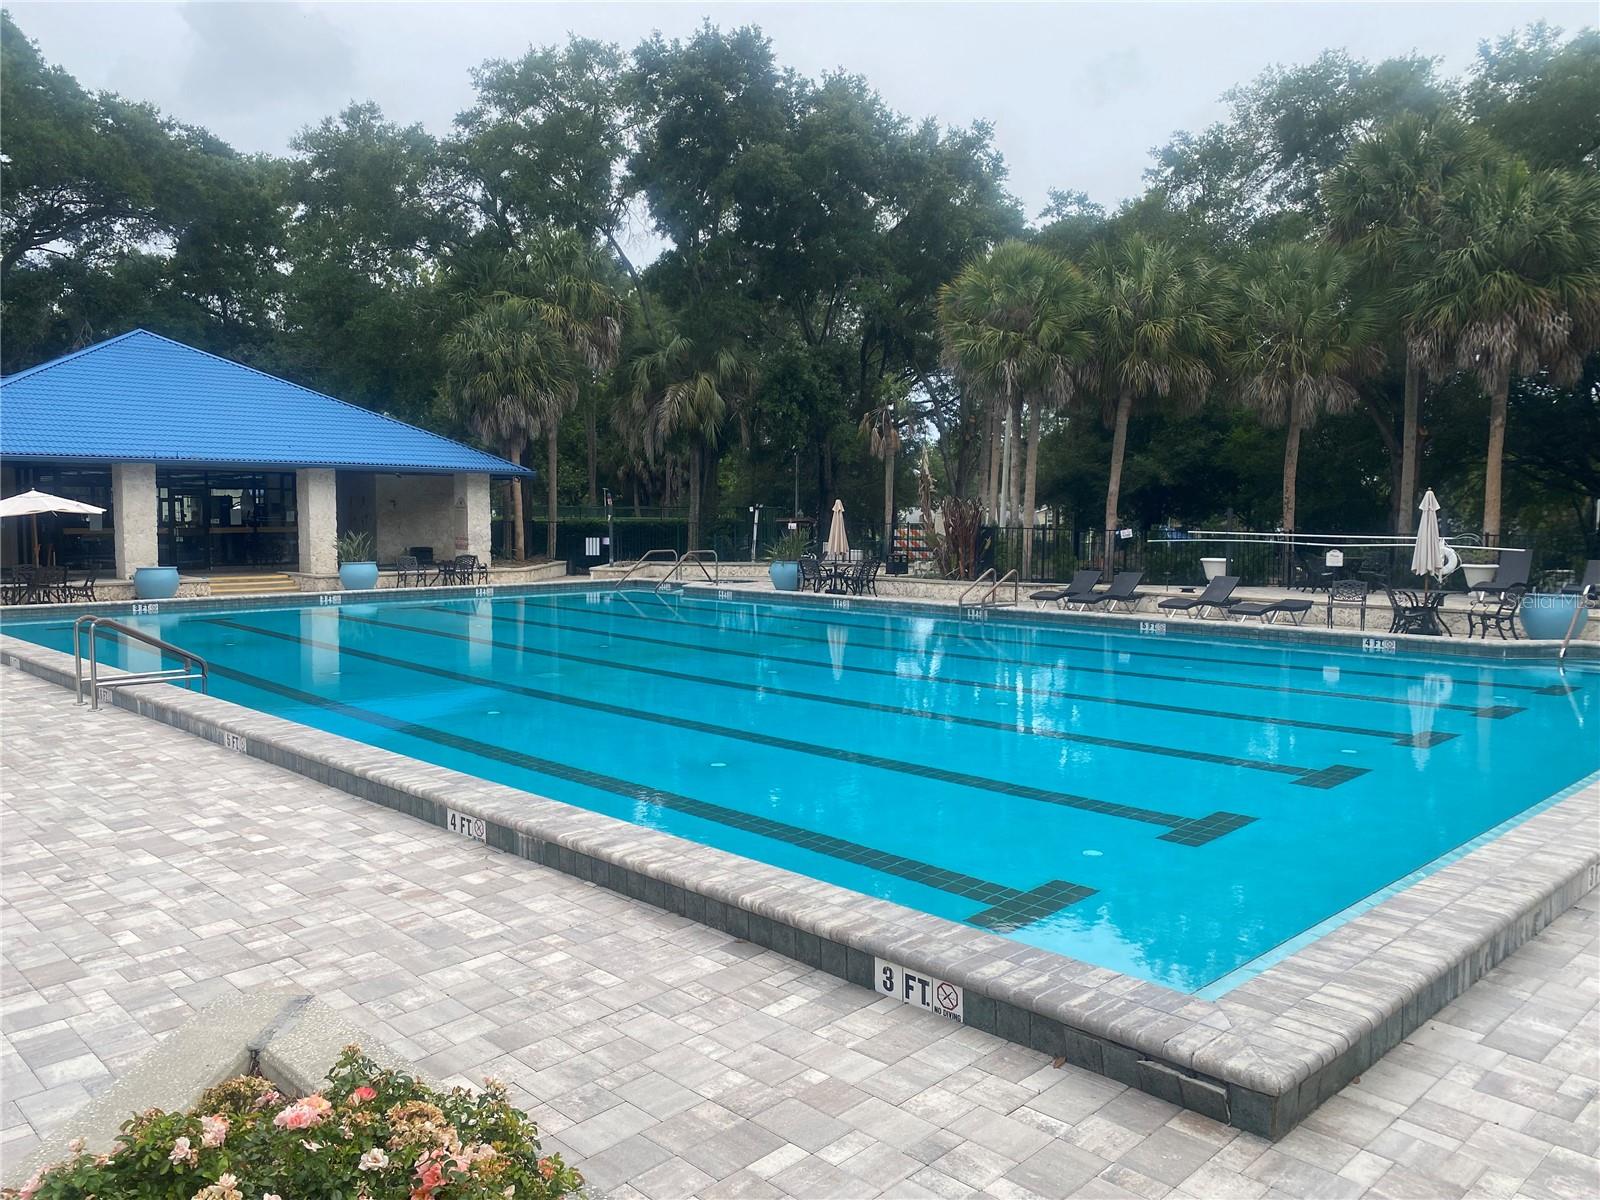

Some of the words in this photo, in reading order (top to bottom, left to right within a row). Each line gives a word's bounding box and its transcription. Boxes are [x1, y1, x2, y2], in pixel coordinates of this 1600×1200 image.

[450, 813, 456, 830] 4
[882, 966, 894, 992] 3
[905, 973, 930, 1007] FT.
[934, 1005, 942, 1015] NO
[943, 1008, 962, 1023] DIVING
